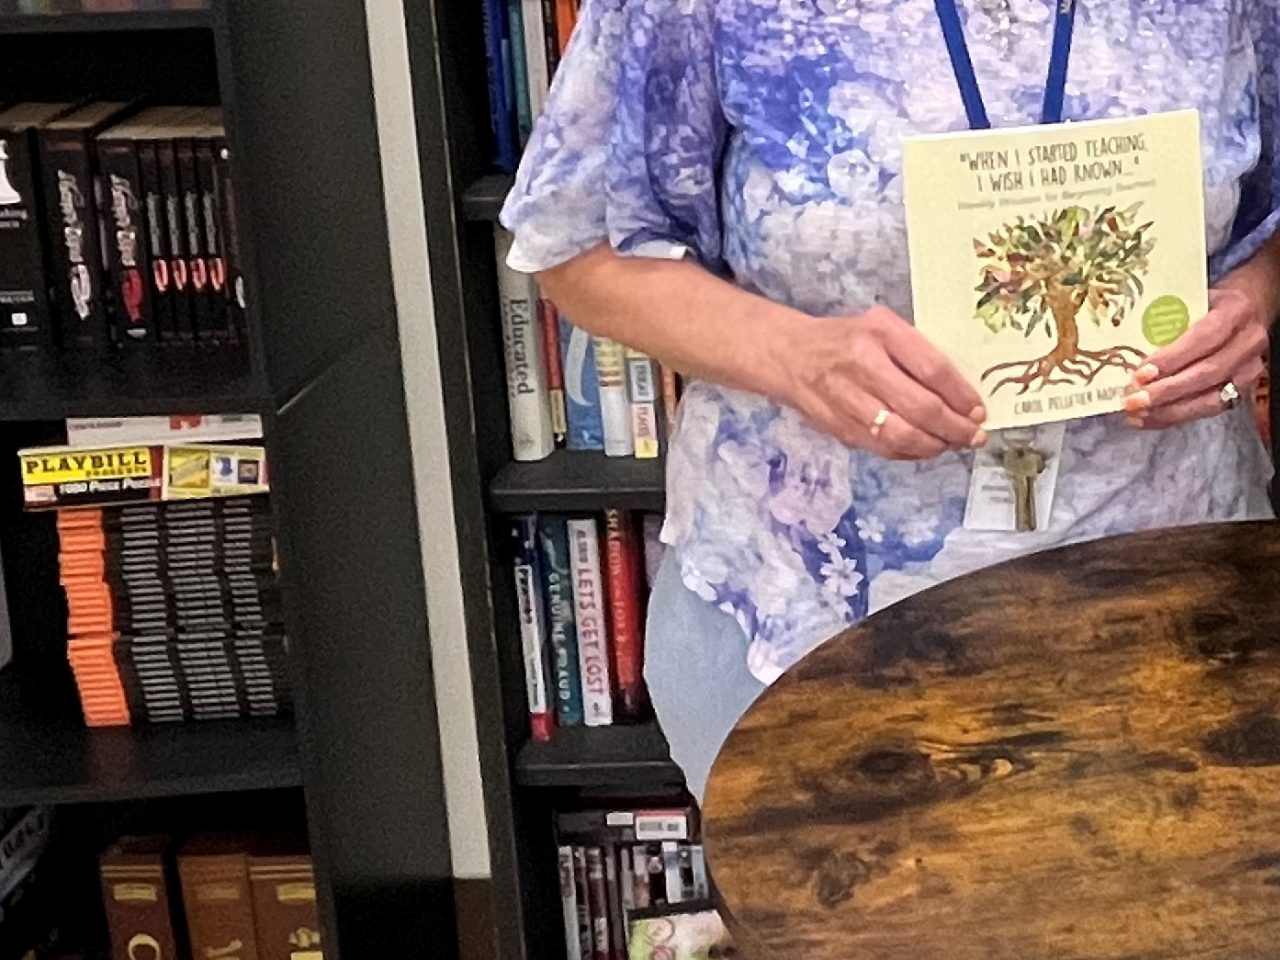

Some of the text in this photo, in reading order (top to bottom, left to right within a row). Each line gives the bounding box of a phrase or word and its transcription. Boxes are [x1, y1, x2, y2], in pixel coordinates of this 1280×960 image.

[1015, 149, 1021, 166] I
[1028, 141, 1078, 167] STARTED
[977, 174, 983, 192] I
[989, 171, 1024, 191] WISH
[1029, 169, 1034, 187] I
[1041, 165, 1067, 186] HAD
[510, 298, 536, 396] Educated
[25, 451, 148, 474] PLAYBILL
[548, 572, 573, 701] GENUINE FRAUD
[581, 617, 601, 652] GET
[586, 653, 604, 696] LOST
